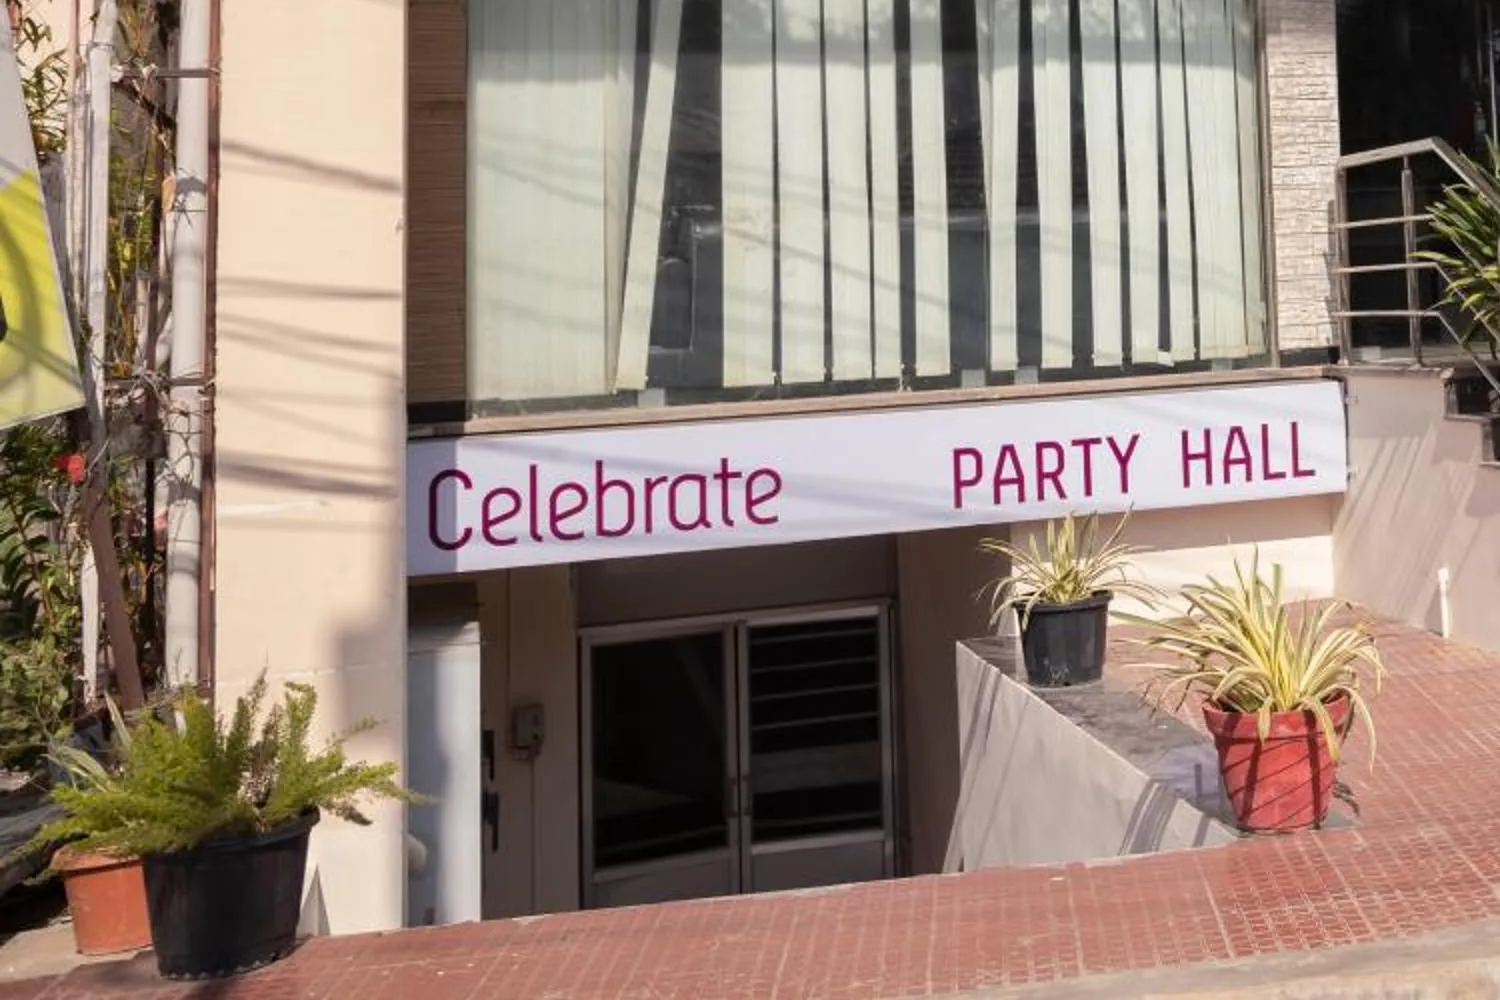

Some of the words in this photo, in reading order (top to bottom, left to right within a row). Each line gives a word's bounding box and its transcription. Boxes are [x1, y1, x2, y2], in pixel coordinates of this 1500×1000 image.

[427, 456, 784, 551] Celebrate
[952, 433, 1142, 509] PARTY
[1180, 420, 1317, 489] HALL
